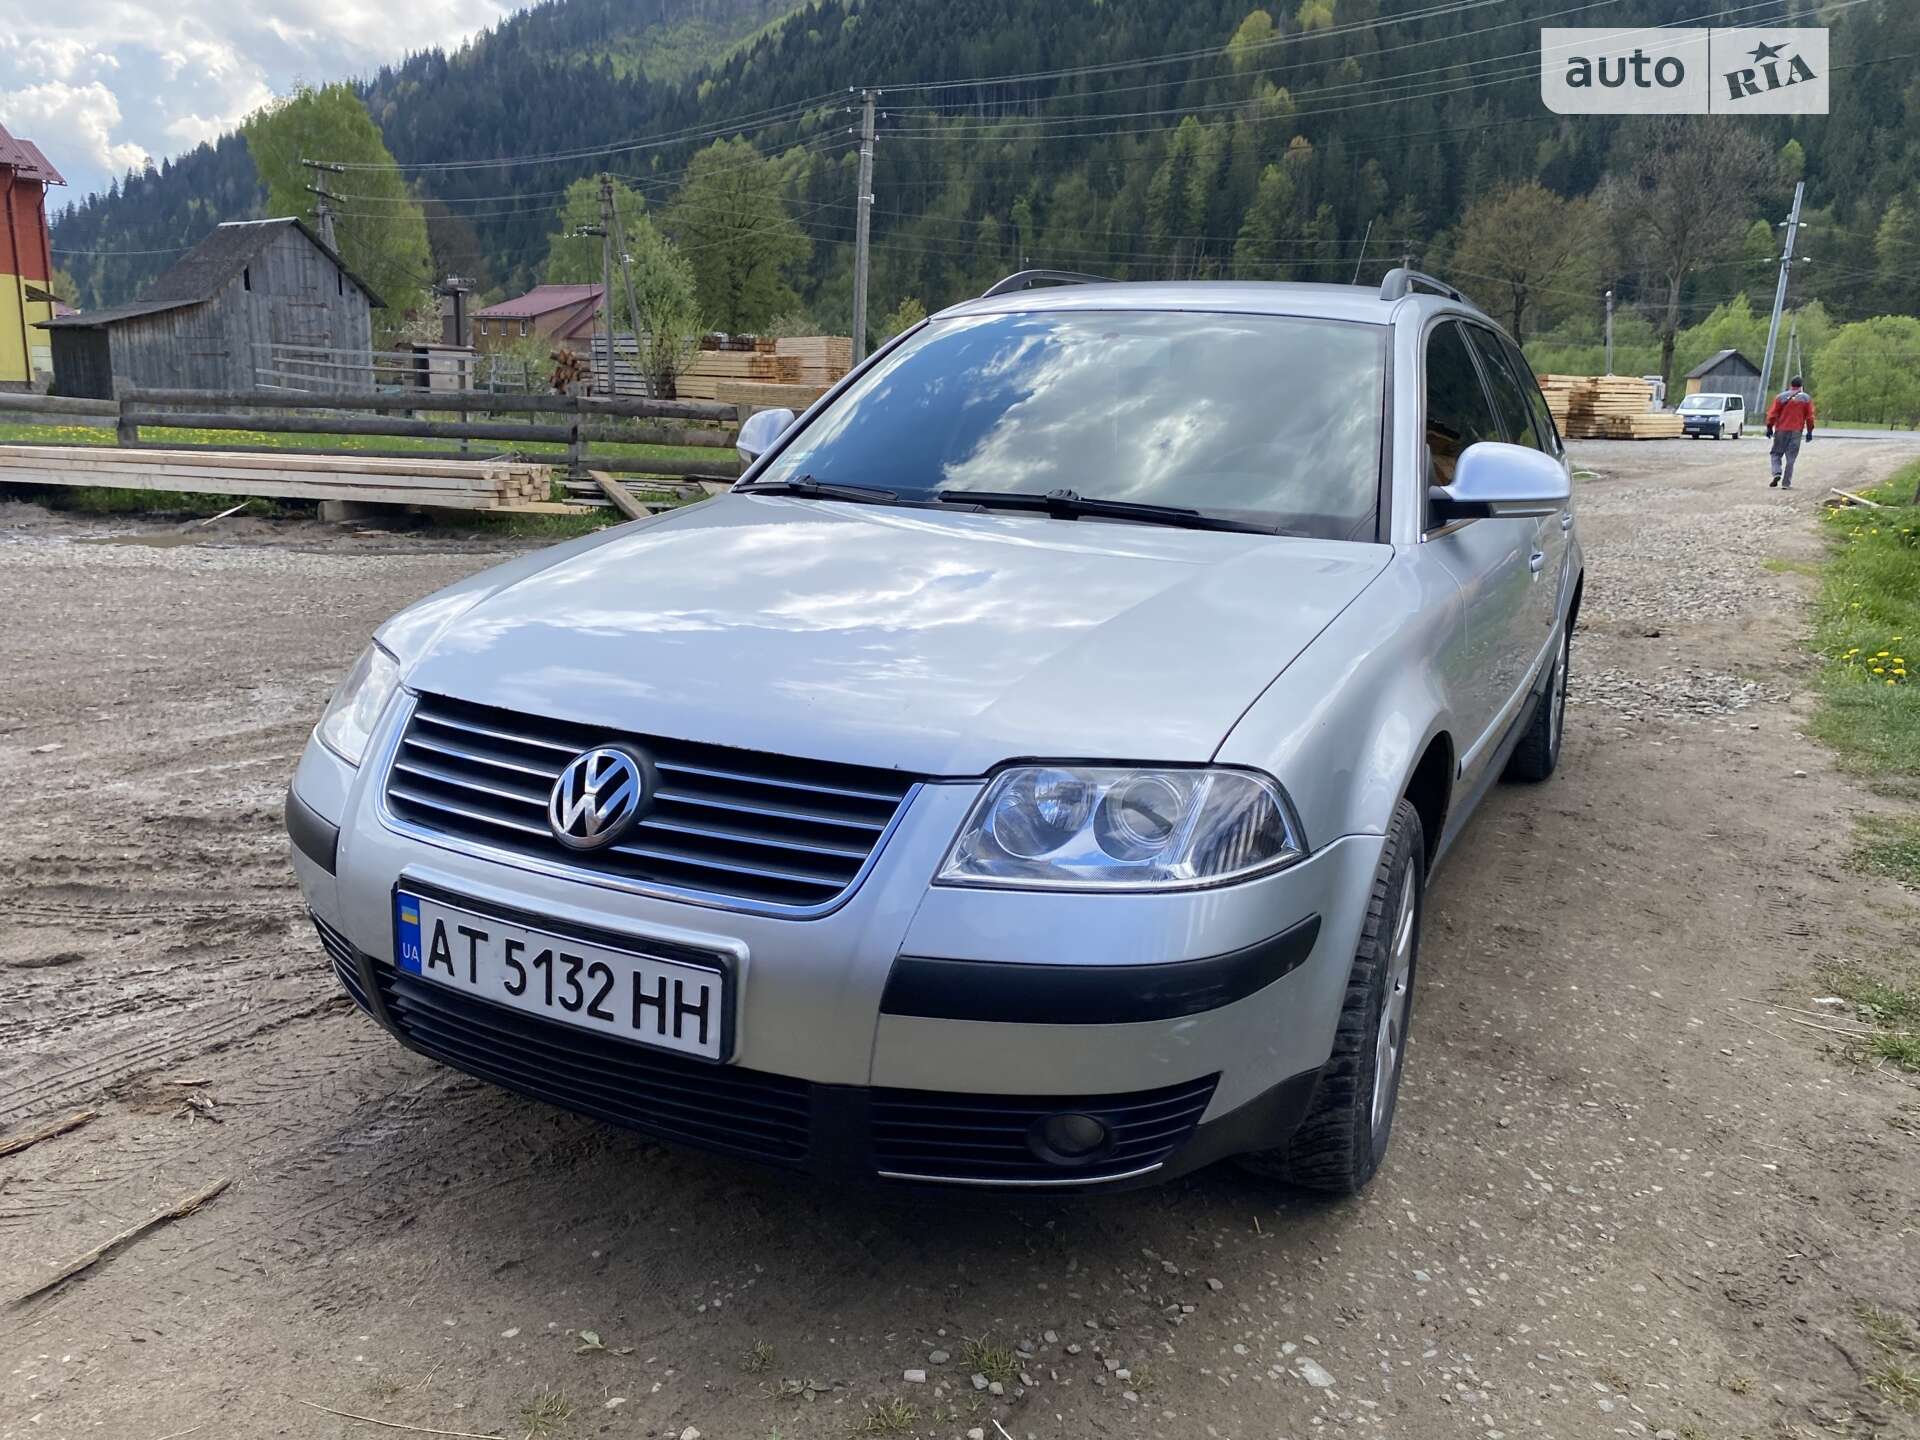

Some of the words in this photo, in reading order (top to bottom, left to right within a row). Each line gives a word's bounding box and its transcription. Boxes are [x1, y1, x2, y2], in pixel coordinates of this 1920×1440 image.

[552, 751, 639, 845] VW
[402, 942, 420, 963] UA
[427, 917, 489, 984] AT
[503, 938, 615, 1022] 5132
[632, 970, 709, 1045] HH
